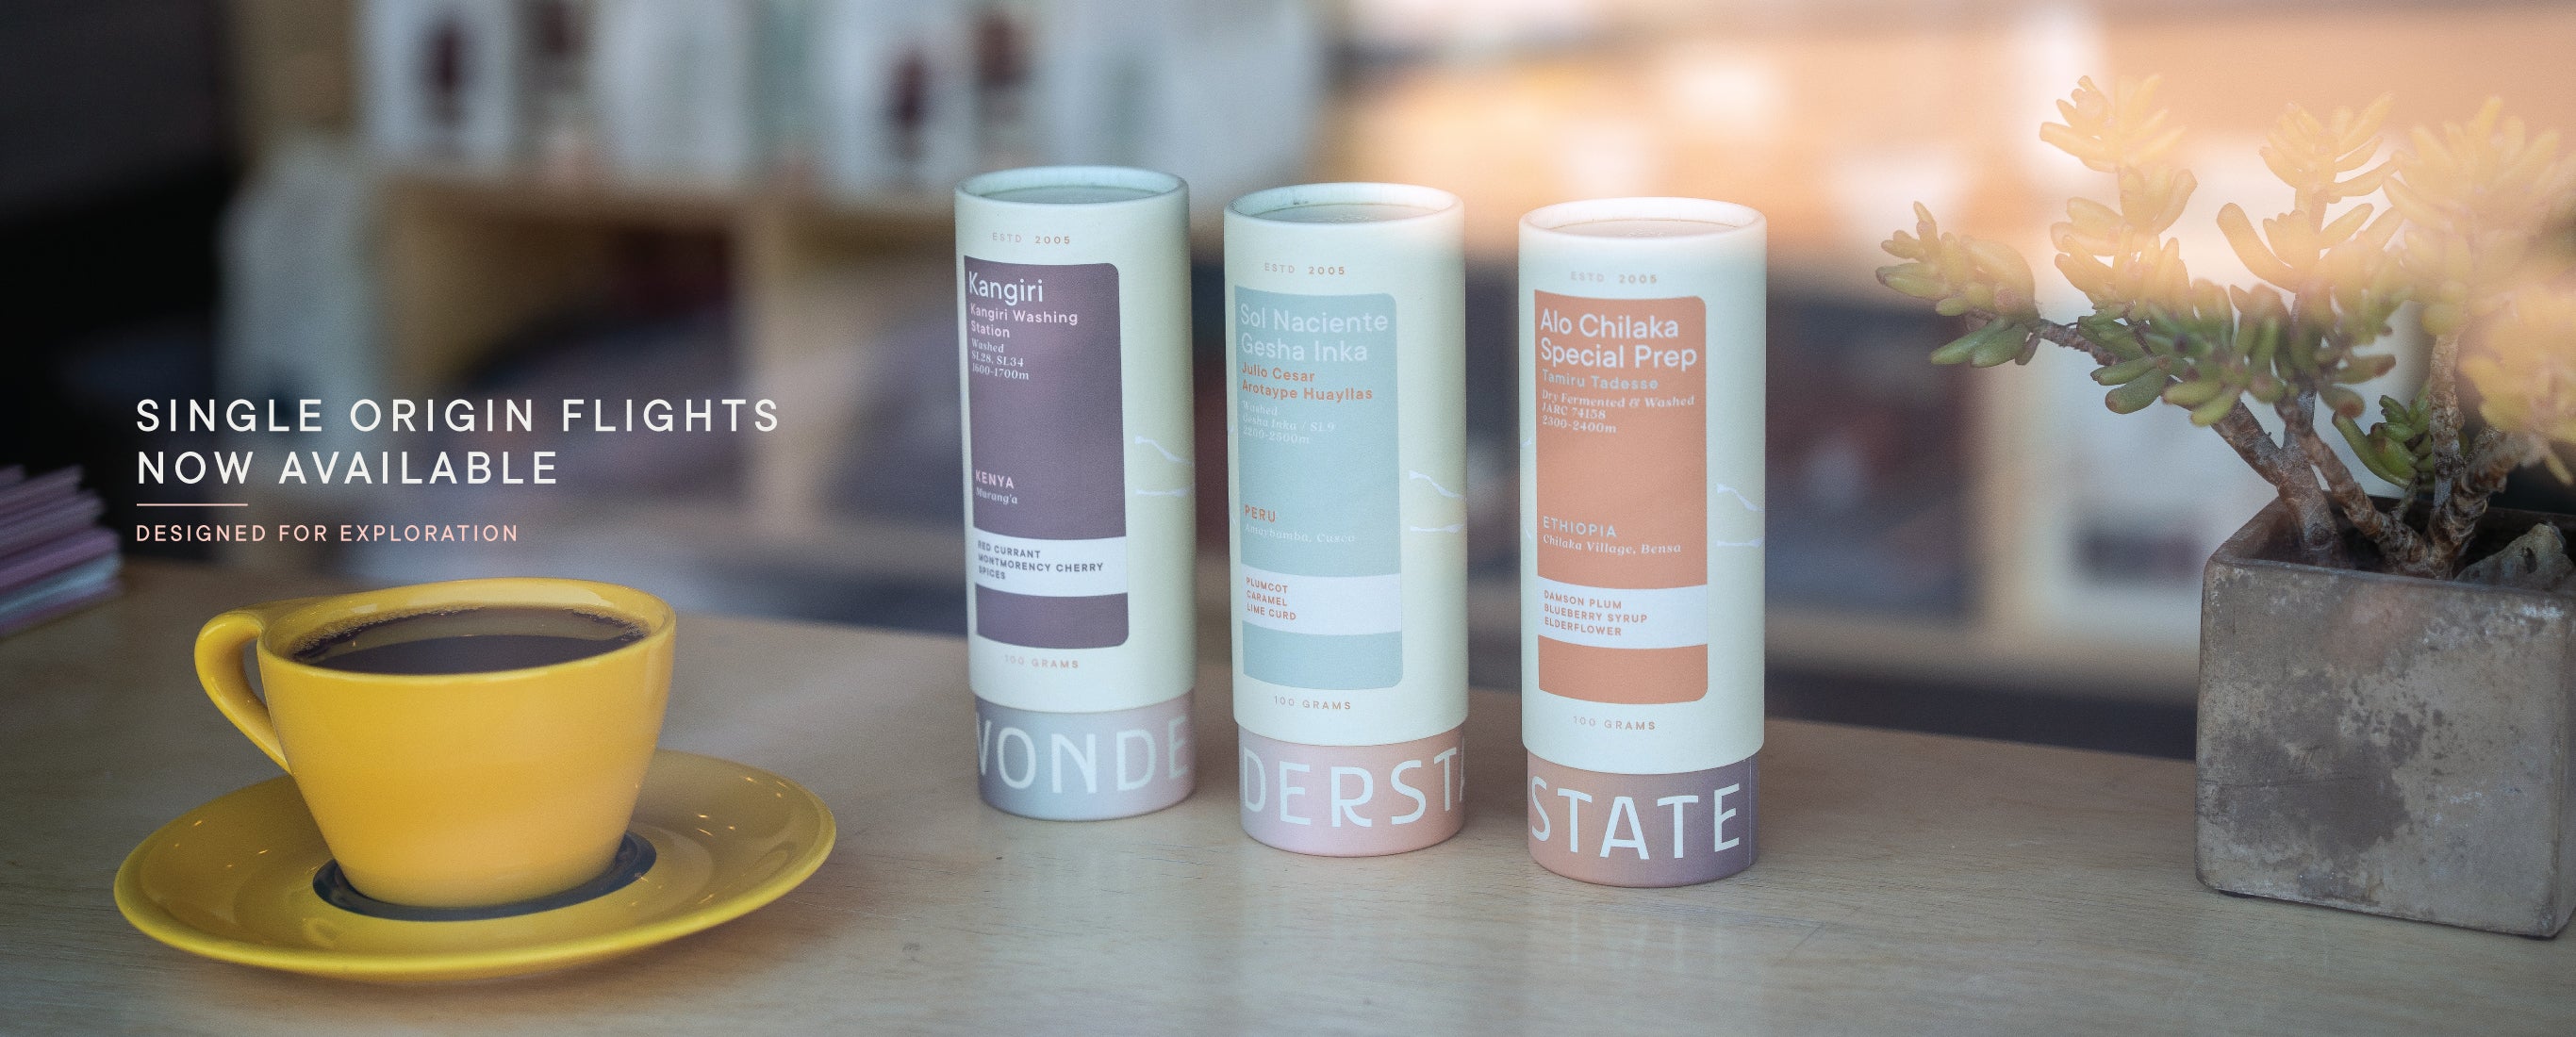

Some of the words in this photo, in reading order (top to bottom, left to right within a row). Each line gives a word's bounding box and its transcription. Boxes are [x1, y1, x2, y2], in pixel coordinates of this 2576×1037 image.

[992, 232, 1022, 243] ESTD
[1034, 235, 1071, 245] 2005
[1264, 262, 1296, 273] ESTD
[1308, 266, 1346, 275] 2005
[1570, 271, 1605, 283] ESTD
[1618, 273, 1658, 284] 2005
[968, 271, 1044, 306] Kangiri
[970, 303, 1009, 321] Kangiri
[1012, 309, 1079, 326] Washing
[1240, 303, 1266, 328] Sol
[1273, 307, 1389, 334] Naciente
[1540, 307, 1573, 335] Alo
[1578, 313, 1679, 339] Chilaka
[970, 321, 1011, 338] Station
[971, 337, 1005, 354] Washed
[1241, 332, 1306, 361] Gesha
[1314, 339, 1368, 363] Inka
[1541, 337, 1624, 369] Special
[1634, 344, 1698, 371] Prep
[996, 354, 1025, 368] SL34
[1272, 367, 1315, 383] Cesar
[1542, 369, 1585, 387] Tamiru
[1591, 374, 1659, 390] Tadesse
[1242, 378, 1298, 400] Arotaype
[1303, 387, 1374, 403] Huayllas
[1542, 388, 1560, 403] Dry
[1560, 392, 1626, 408] Fermented
[1628, 397, 1641, 408] &
[1644, 394, 1695, 408] Washed
[975, 469, 1015, 489] KENYA
[976, 486, 1018, 505] Murang'a
[1244, 504, 1277, 523] PERU
[1543, 516, 1617, 537] ETHIOPIA
[977, 539, 992, 552] RED
[994, 544, 1042, 559] CURRANT
[1543, 534, 1582, 551] Chilaka
[1587, 541, 1637, 555] Village,
[1641, 543, 1681, 554] Bensa
[978, 552, 1051, 572] MONTMORENCY
[1055, 562, 1104, 572] CHERRY
[979, 567, 1006, 581] SPICES
[1246, 576, 1289, 594] PLUMCOT
[1246, 589, 1288, 607] CARAMEL
[1544, 589, 1585, 606] DAMSON
[1589, 598, 1622, 610] PLUM
[1247, 602, 1265, 616] LIME
[1268, 608, 1296, 620] CURD
[1544, 603, 1602, 621] BLUEBERRY
[1608, 614, 1648, 623] SYRUP
[1544, 617, 1622, 636] ELDERFLOWER
[1004, 654, 1025, 666] 100
[1032, 658, 1081, 669] GRAMS
[1274, 695, 1295, 707] 100
[1302, 700, 1352, 710] GRAMS
[1573, 716, 1596, 727] 100
[1604, 719, 1657, 731] GRAMS
[1531, 775, 1740, 860] STATE
